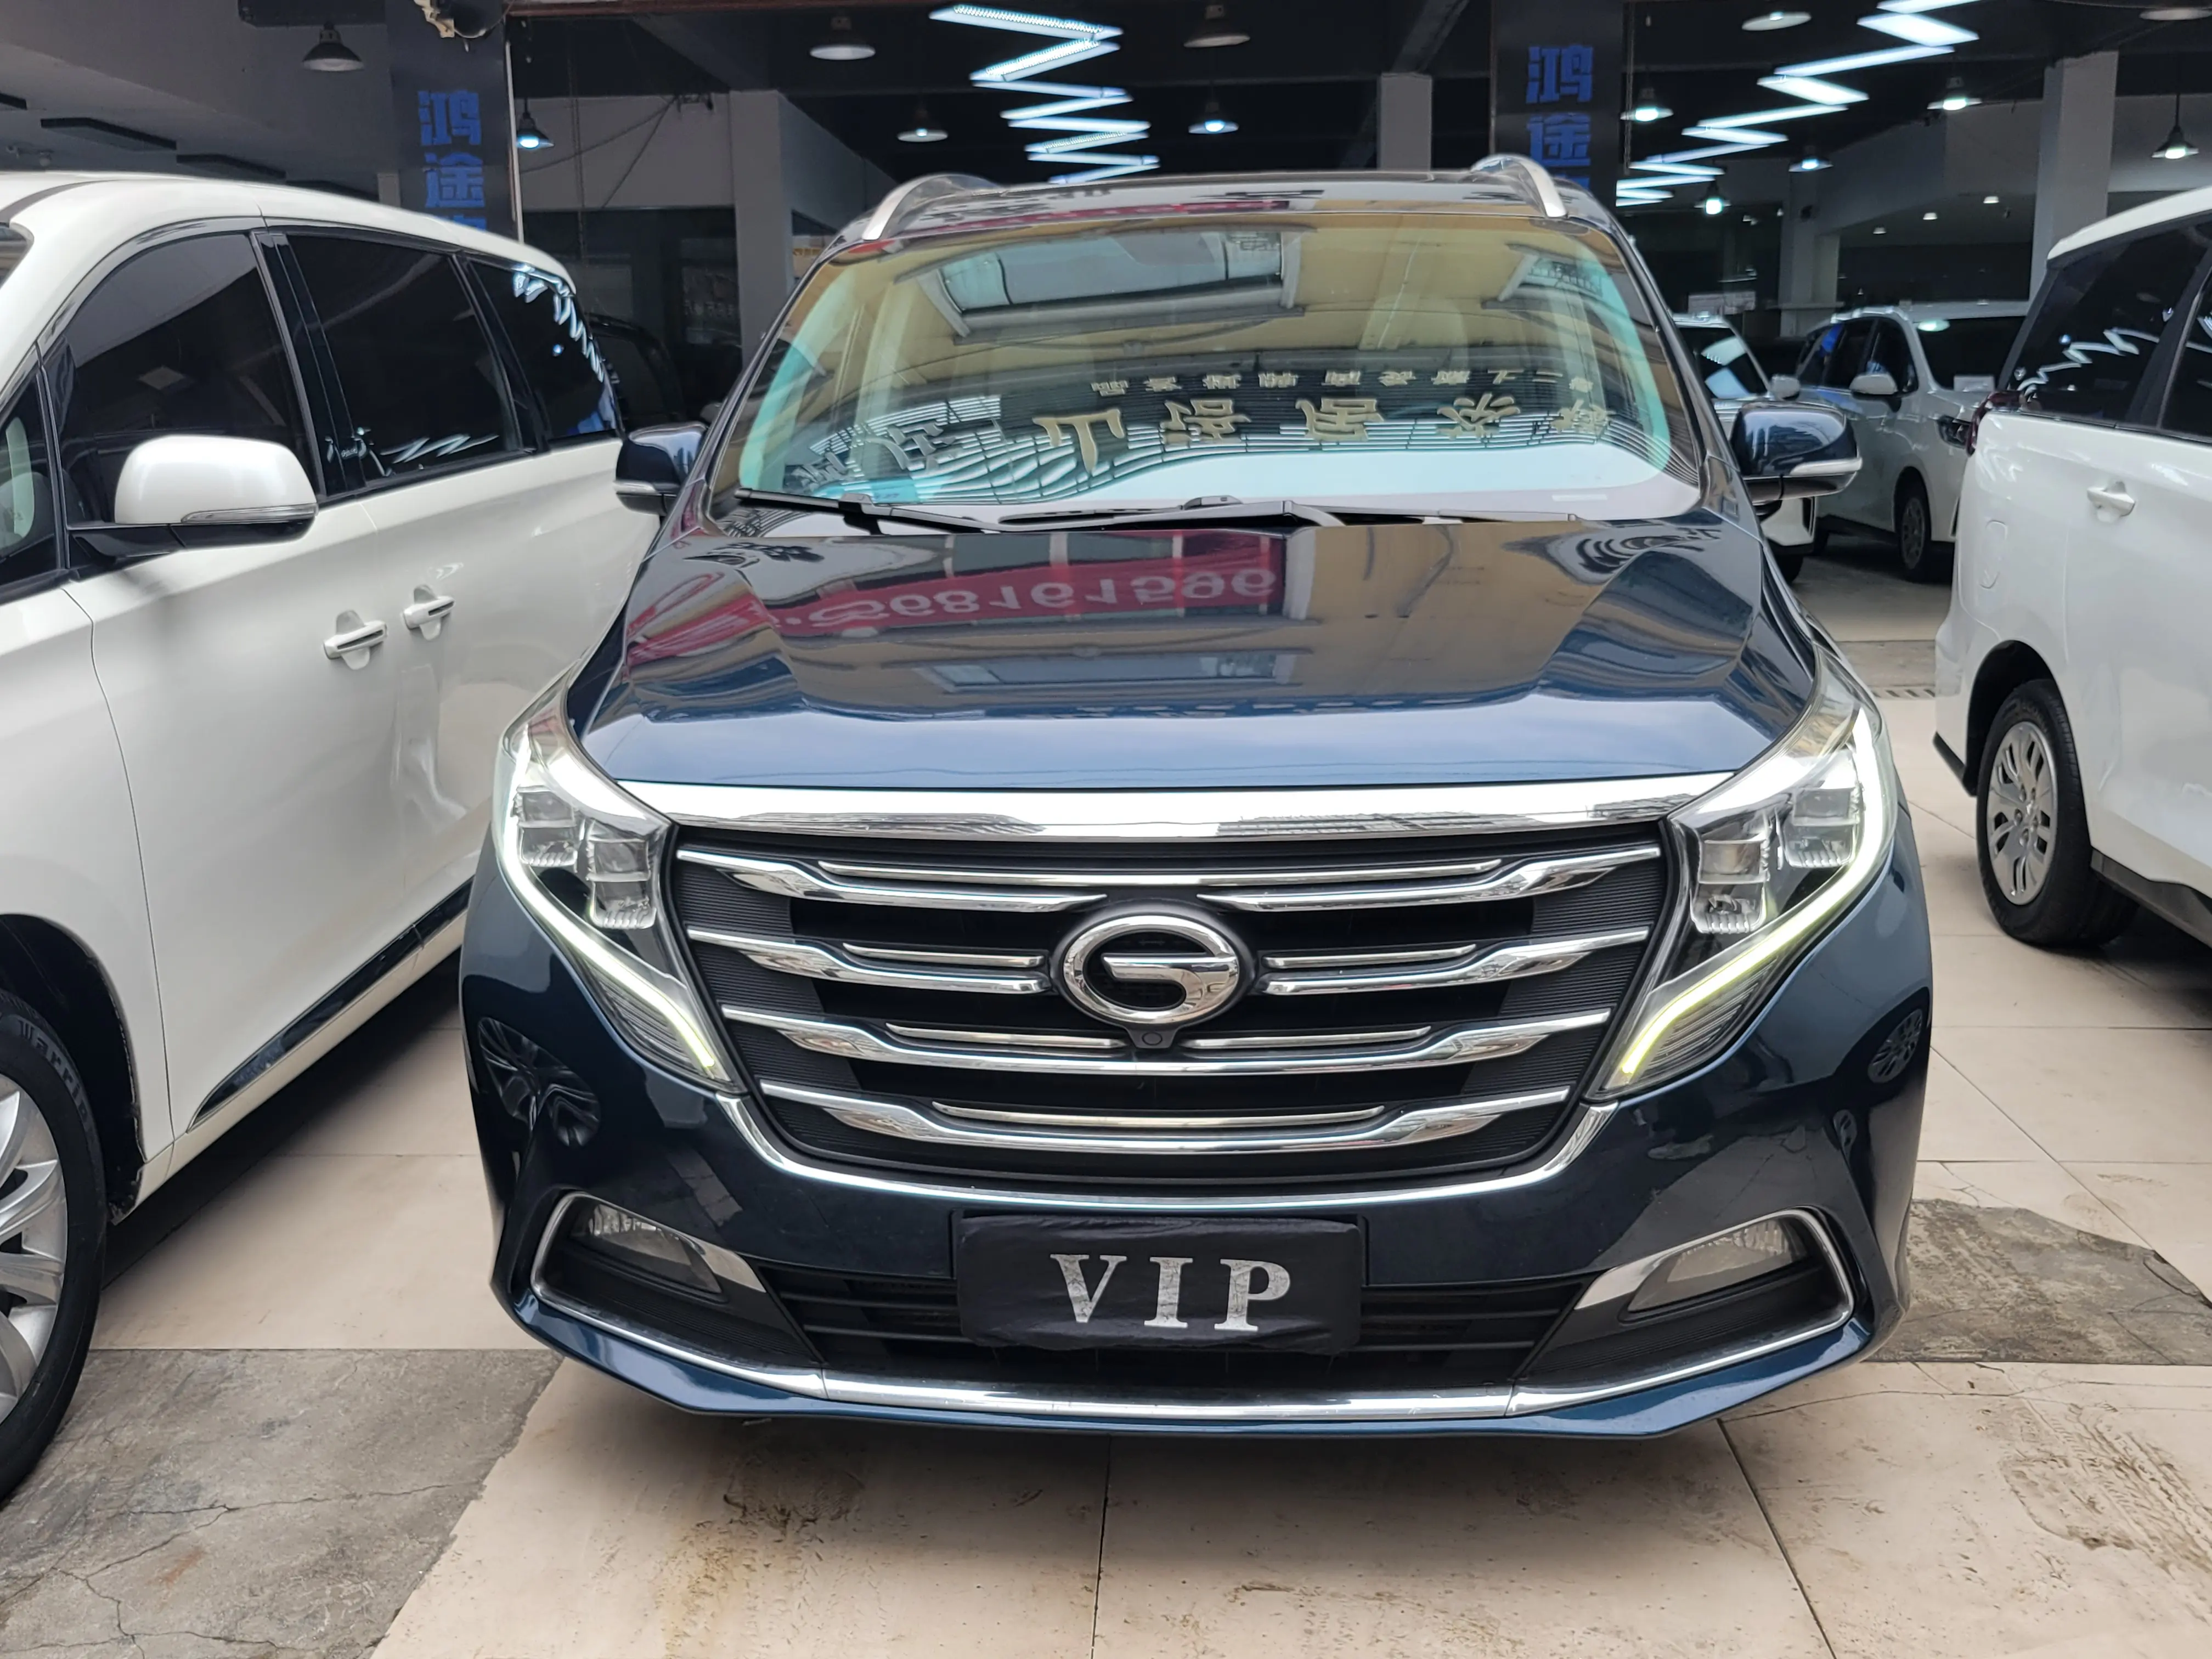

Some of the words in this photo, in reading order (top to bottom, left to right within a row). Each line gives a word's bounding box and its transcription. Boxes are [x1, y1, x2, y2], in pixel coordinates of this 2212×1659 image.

[417, 90, 487, 231] 鸿途
[1526, 45, 1594, 188] 鸿途
[1049, 1254, 1291, 1332] VIP
